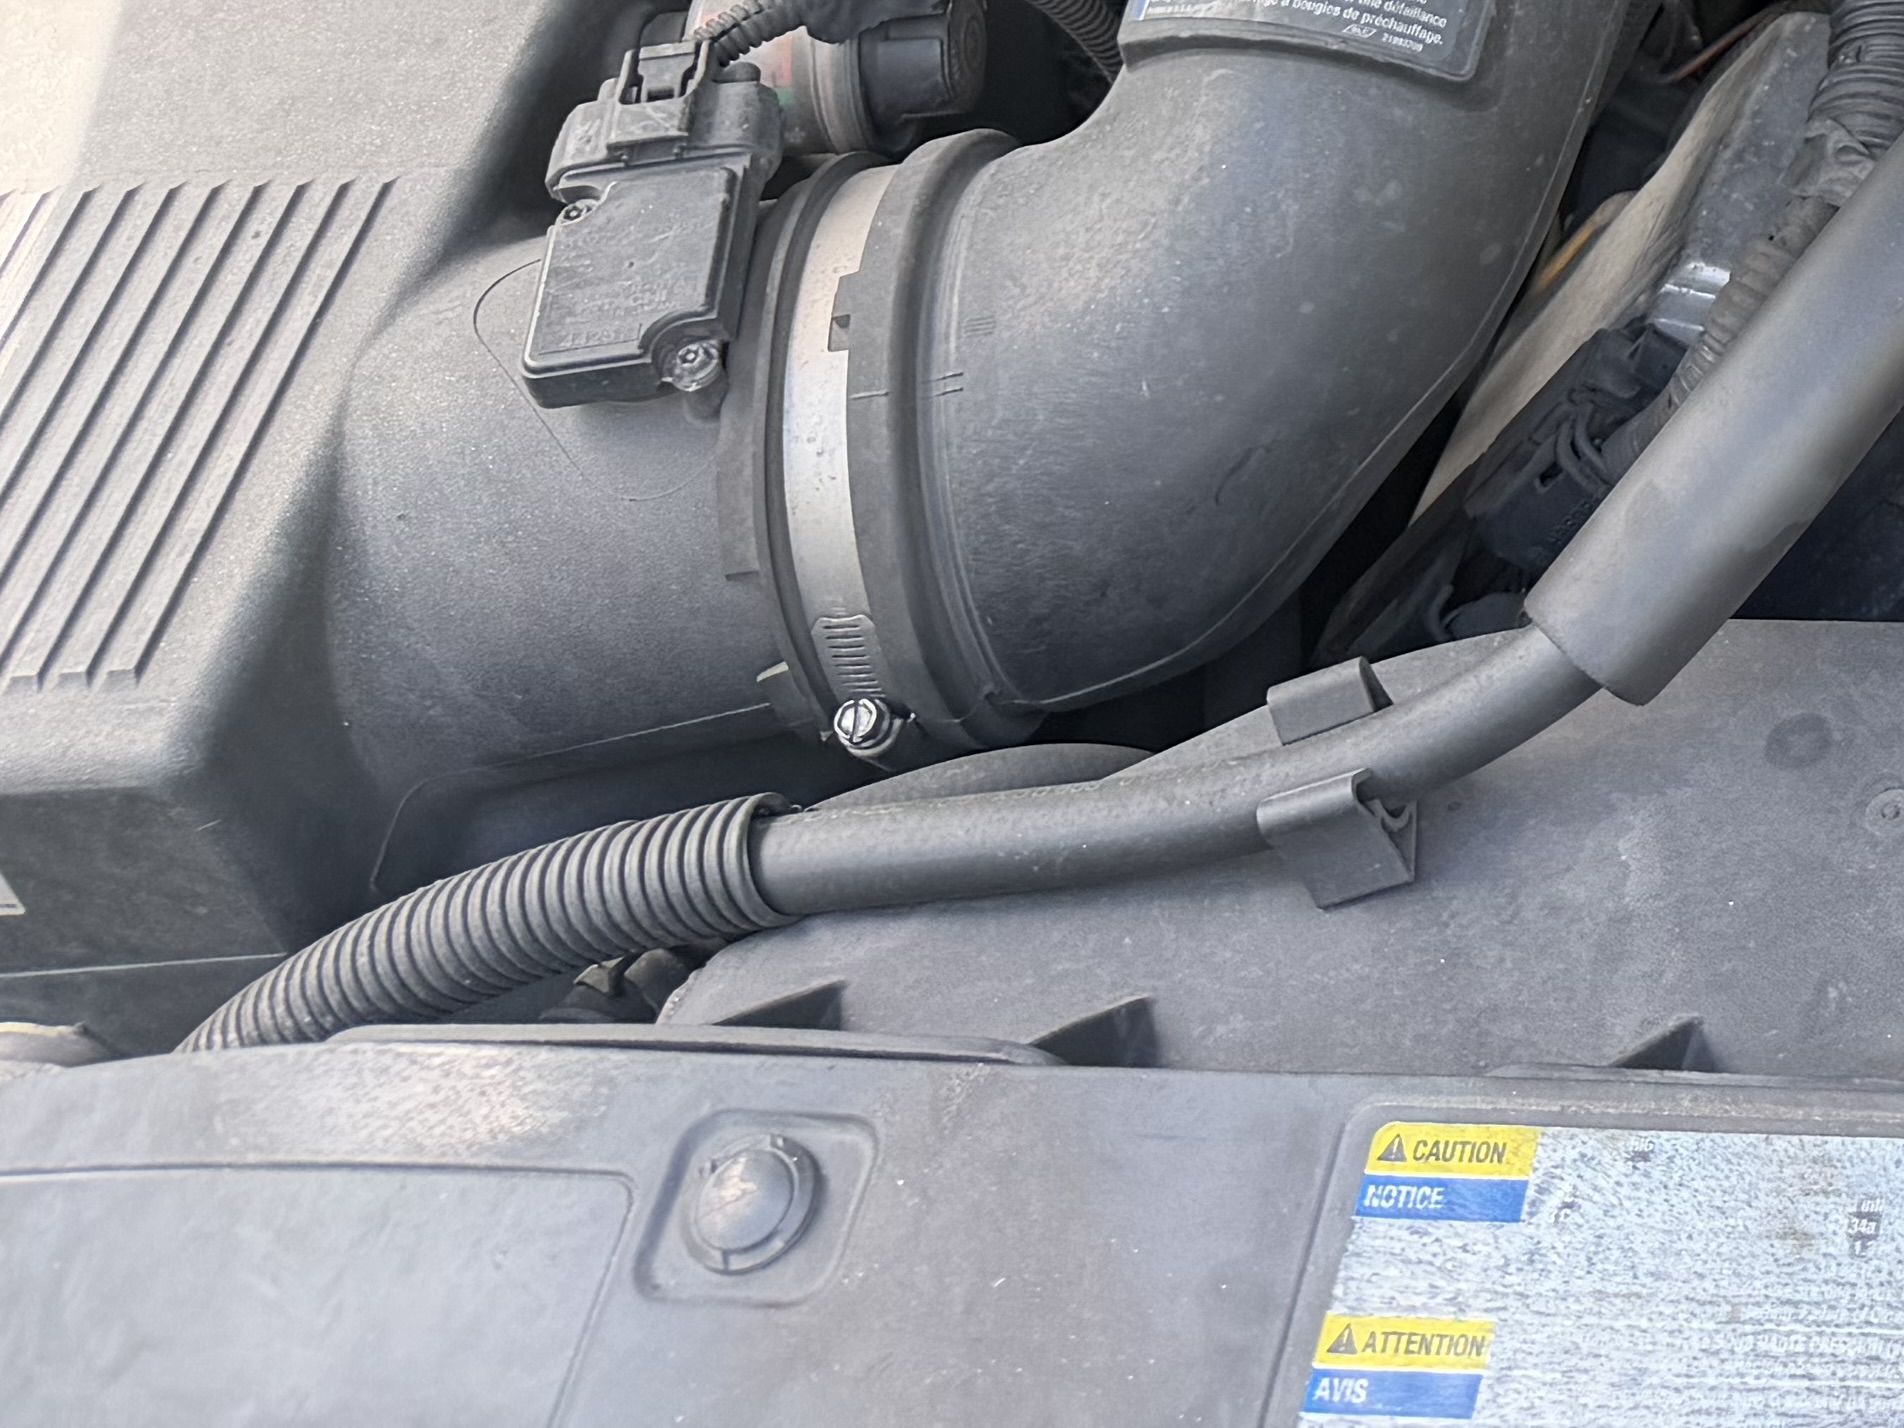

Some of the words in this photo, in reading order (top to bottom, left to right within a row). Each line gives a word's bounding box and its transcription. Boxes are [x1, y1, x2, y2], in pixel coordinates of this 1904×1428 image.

[1342, 6, 1358, 20] de
[1361, 13, 1443, 45] préchauffage.
[1384, 1, 1448, 28] défaillance
[1411, 1138, 1507, 1165] CAUTION
[1362, 1184, 1446, 1210] NOTICE
[1361, 1330, 1487, 1357] ATTENTION
[1312, 1376, 1369, 1404] AVIS
